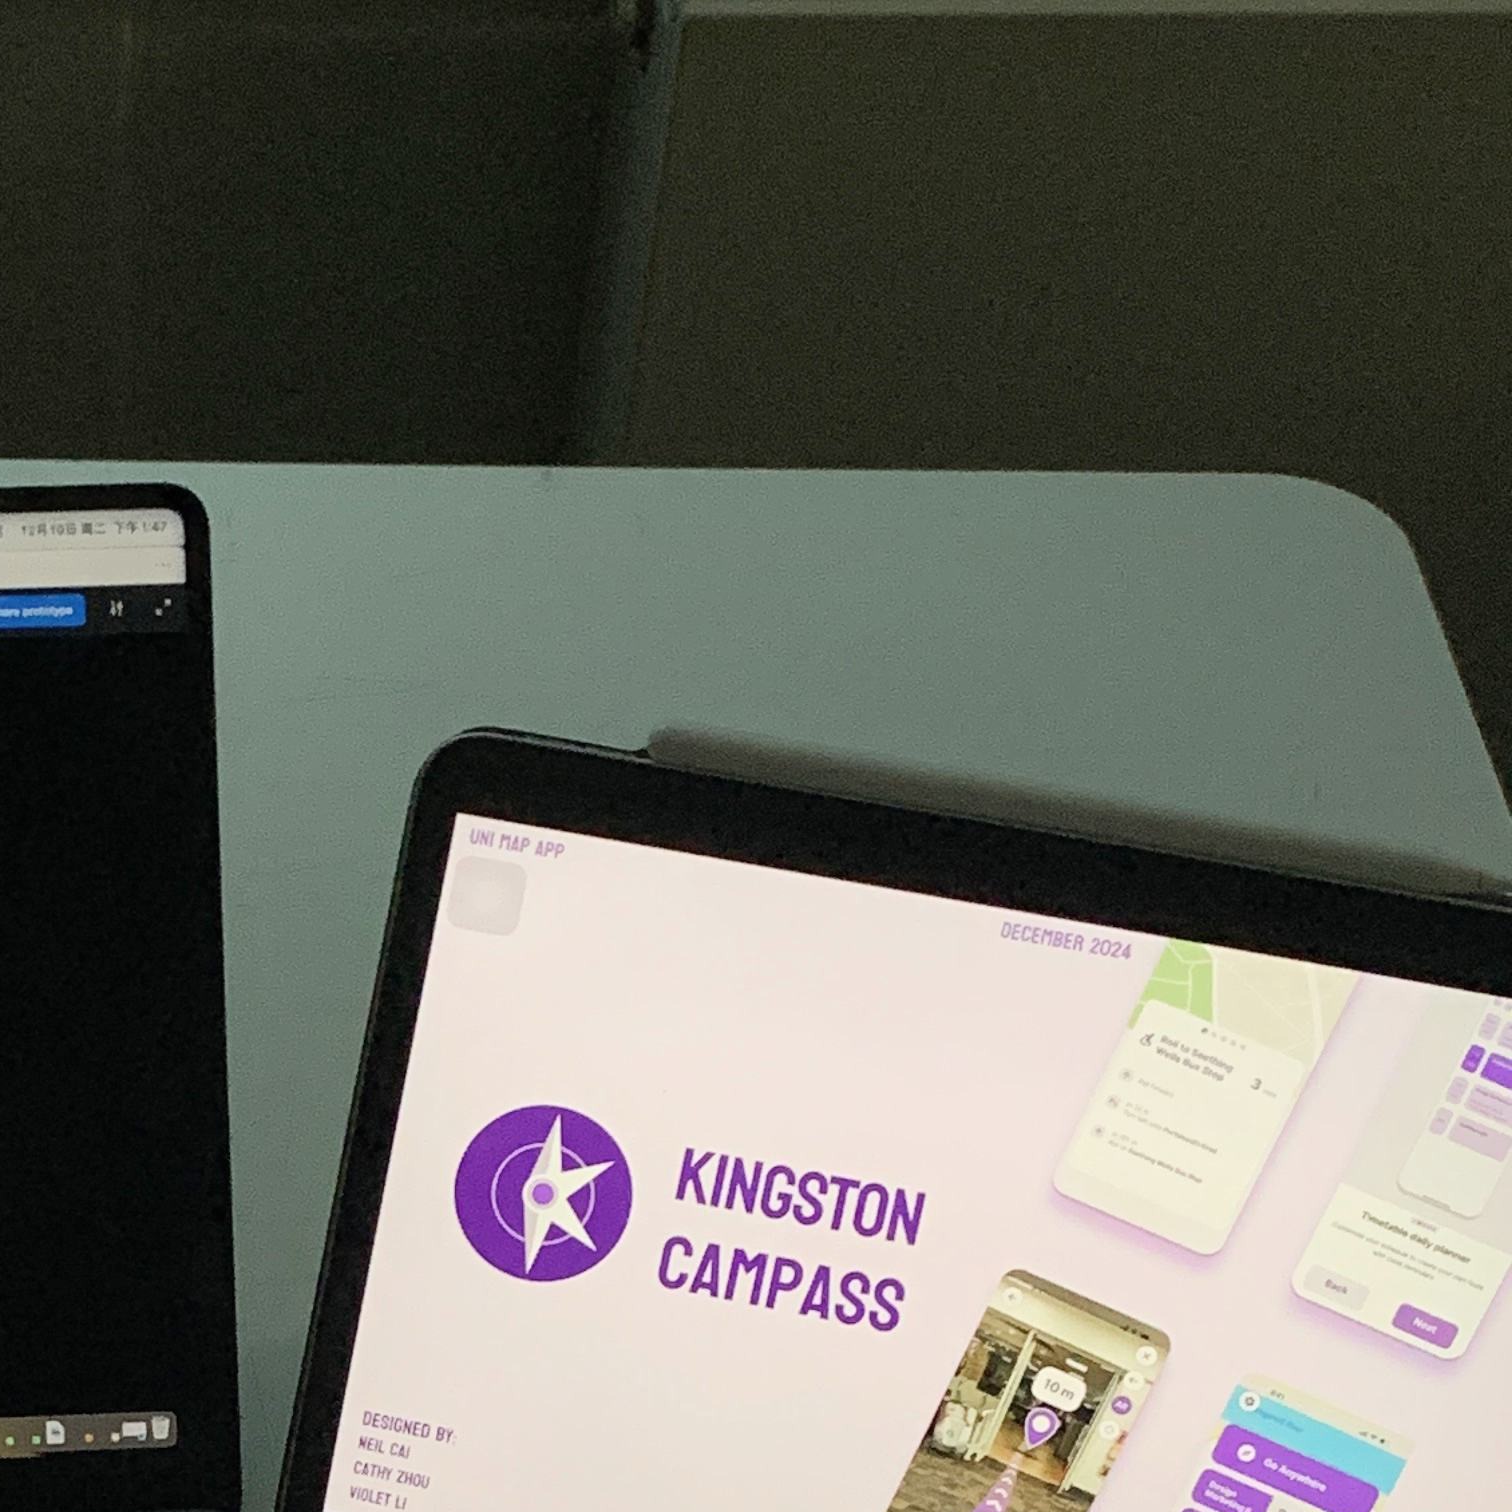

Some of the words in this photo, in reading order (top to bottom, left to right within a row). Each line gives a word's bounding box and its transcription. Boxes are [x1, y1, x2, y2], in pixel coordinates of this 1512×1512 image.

[469, 827, 495, 848] UNI
[498, 833, 530, 853] MAP
[534, 840, 565, 859] APP
[999, 920, 1084, 952] DECEMBER
[1089, 936, 1134, 960] 2024
[1249, 1077, 1263, 1091] 3
[674, 1146, 927, 1246] KINGSTON
[657, 1235, 906, 1332] CAMPASS
[1324, 1278, 1348, 1295] Back
[1411, 1316, 1439, 1336] Next
[1044, 1377, 1061, 1393] 10
[1060, 1388, 1075, 1401] m
[362, 1409, 431, 1439] DESIGNED
[358, 1434, 386, 1455] NEIL
[389, 1441, 411, 1460] CAI
[353, 1460, 393, 1481] CATHY
[395, 1469, 431, 1490] ZHOU
[1262, 1457, 1279, 1471] Go
[1278, 1464, 1327, 1492] Anywhere
[349, 1485, 392, 1507] VIOLET
[394, 1494, 408, 1511] LI
